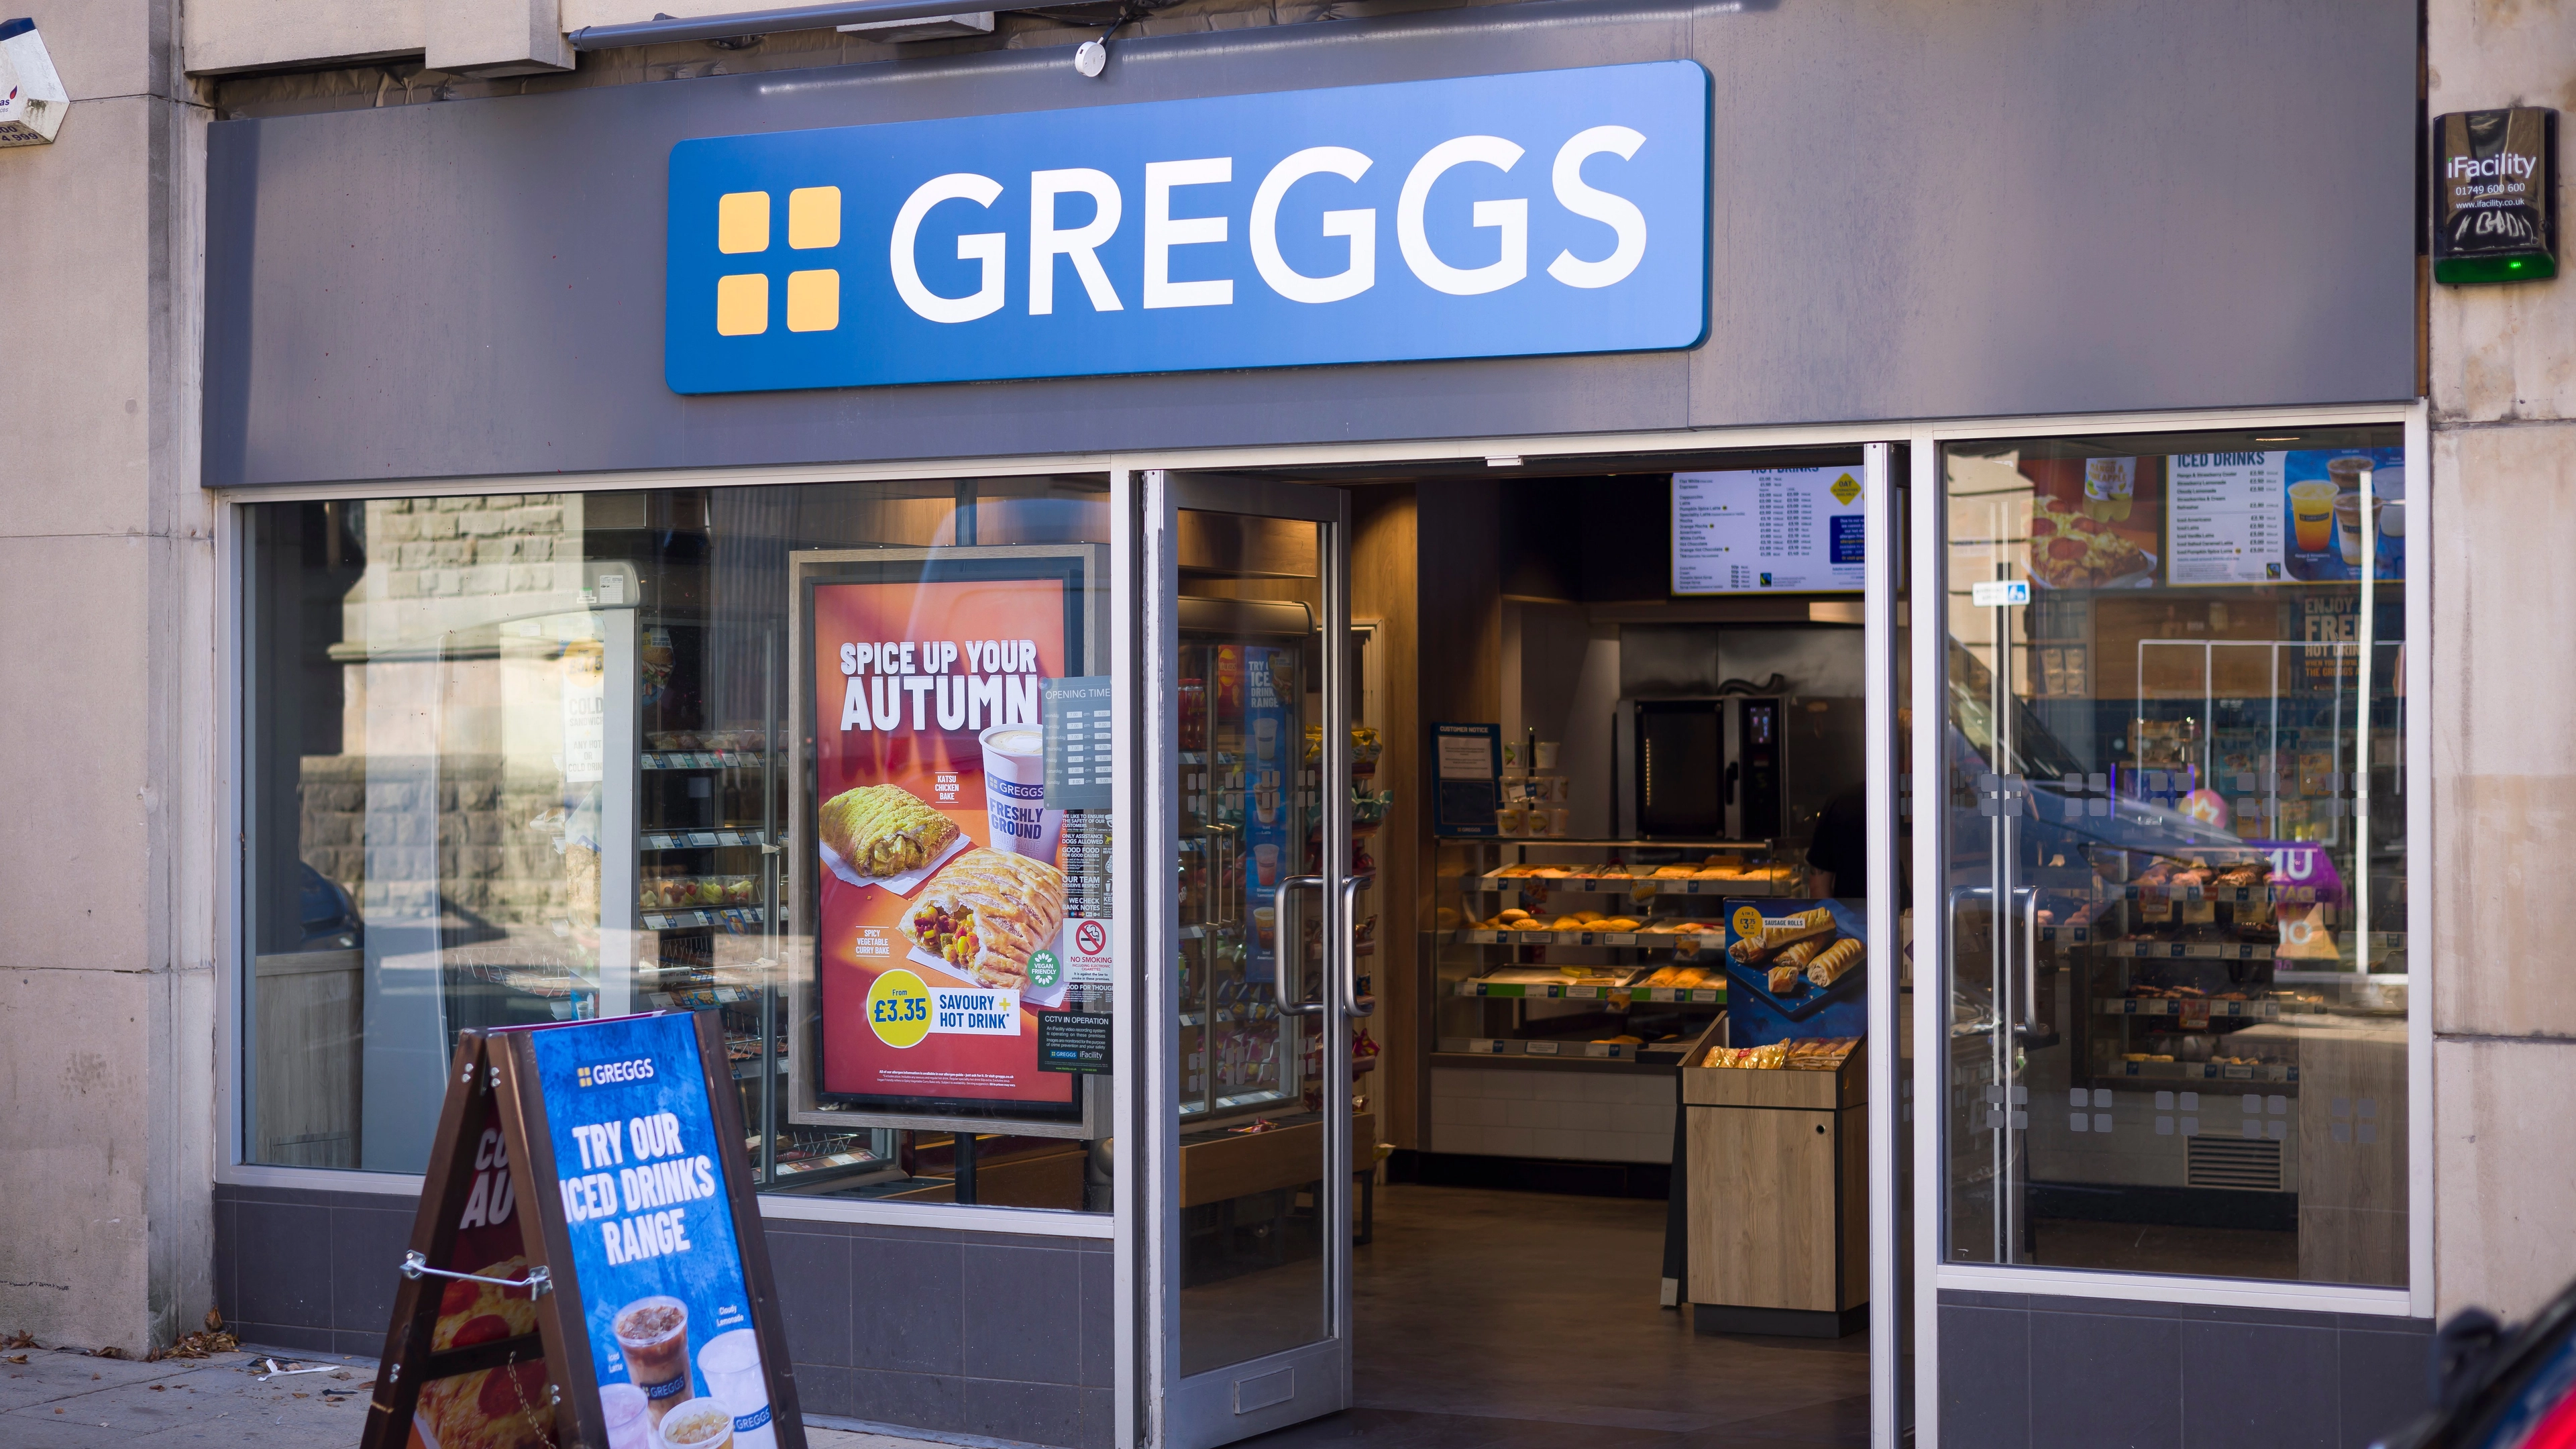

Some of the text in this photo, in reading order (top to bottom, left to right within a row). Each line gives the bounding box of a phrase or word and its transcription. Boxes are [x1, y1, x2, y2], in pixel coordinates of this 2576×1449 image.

[2447, 153, 2536, 178] iFacility
[2456, 183, 2525, 195] 01749 600 600
[2456, 198, 2524, 209] www.ifacility.co.uk
[890, 125, 1648, 323] GREGGS
[2178, 451, 2265, 468] ICED DRINKS
[2305, 597, 2353, 614] ENJOY
[2333, 644, 2360, 657] DRIN
[840, 639, 1037, 675] SPICE UP YOUR
[1248, 661, 1265, 671] TRY
[2322, 667, 2353, 677] GREGS
[1251, 672, 1271, 687] ICE
[1045, 688, 1111, 699] OPENING TIME
[1251, 688, 1275, 696] DRINK
[569, 697, 603, 715] COLD
[840, 674, 1038, 731] AUTUMN
[1251, 698, 1279, 708] RANGE
[574, 740, 602, 749] ANY HOT
[584, 751, 593, 760] OR
[568, 762, 602, 772] COLD DRIN
[937, 775, 957, 784] KATSU
[934, 784, 959, 792] CHICKEN
[1000, 783, 1044, 797] GREGGS
[939, 792, 955, 800] BAKE
[989, 797, 1044, 822] FRESHLY
[991, 814, 1042, 839] GROUND
[864, 930, 880, 938] SPICY
[857, 938, 888, 946] VEGETABLE
[856, 947, 890, 955] CURRY BAKE
[892, 989, 908, 997] From
[939, 994, 995, 1011] SAVOURY
[874, 998, 926, 1022] £3.35
[939, 1012, 965, 1028] HOT
[1071, 1016, 1109, 1025] OPERATION
[1079, 1051, 1103, 1060] iFacility
[594, 1059, 654, 1085] GREGGS
[572, 1112, 684, 1170] TRY OUR
[559, 1155, 716, 1224] ICED DRINKS
[602, 1208, 691, 1267] RANGE
[719, 1305, 737, 1316] Cloudy
[716, 1313, 744, 1327] Lemonade
[608, 1352, 620, 1362] Iced
[608, 1362, 623, 1373] Latte
[650, 1377, 684, 1397] GREGGS
[736, 1409, 770, 1430] GREGGS
